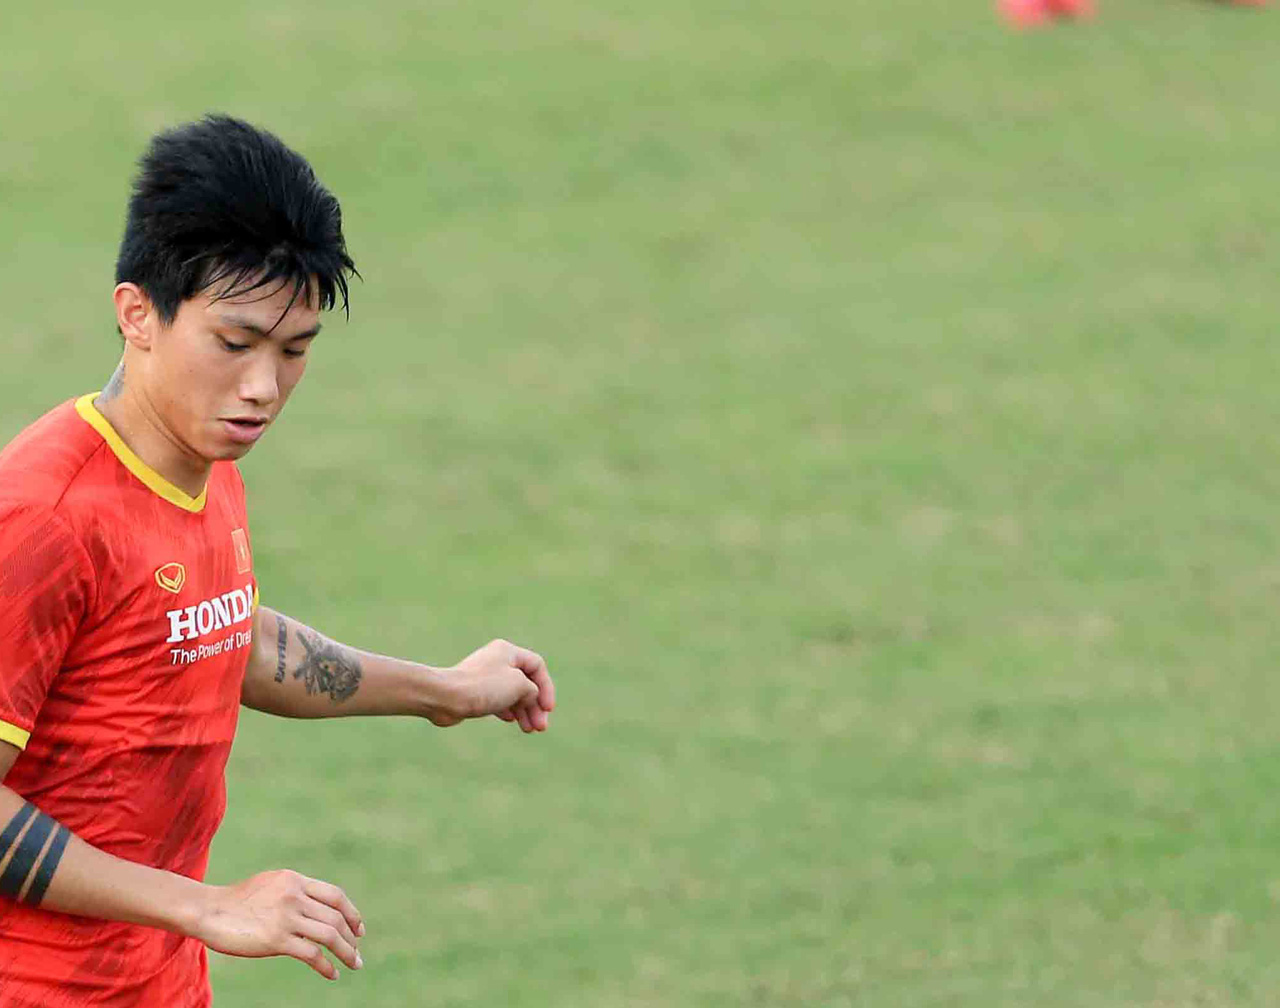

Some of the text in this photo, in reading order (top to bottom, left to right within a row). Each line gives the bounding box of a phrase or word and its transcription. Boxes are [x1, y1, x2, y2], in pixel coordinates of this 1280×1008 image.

[170, 648, 198, 666] The
[197, 640, 224, 661] Power
[224, 633, 235, 652] of
